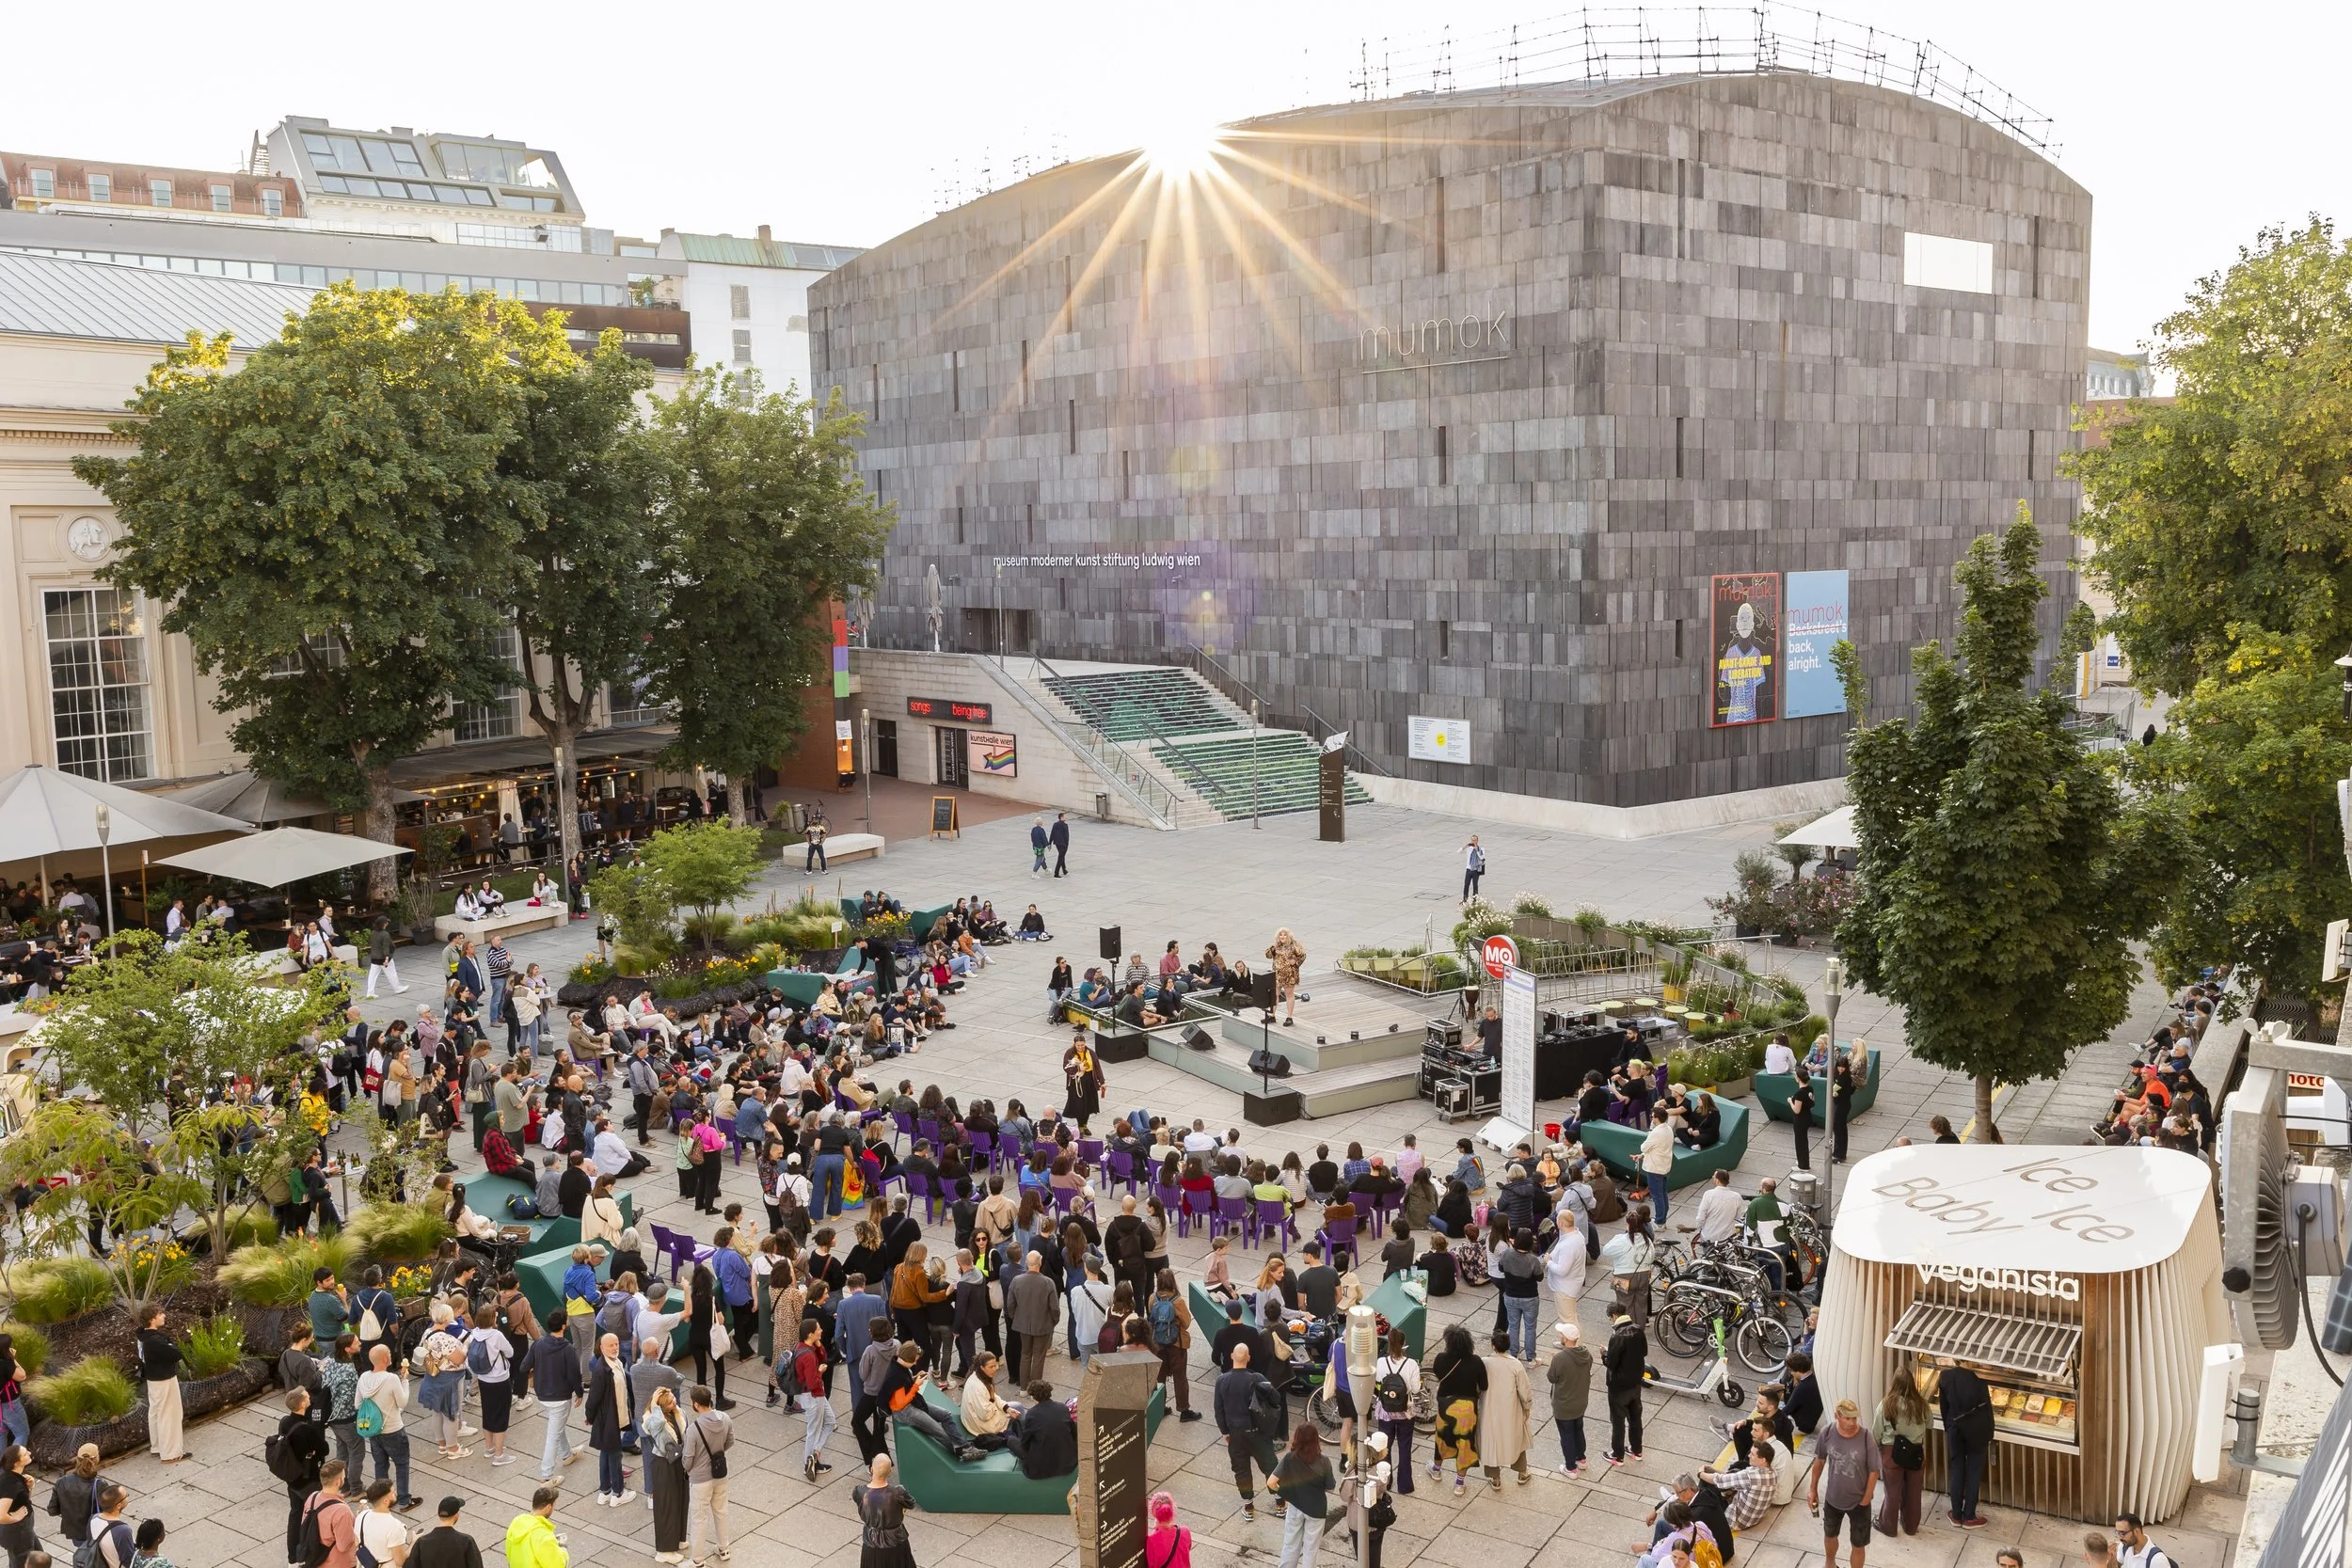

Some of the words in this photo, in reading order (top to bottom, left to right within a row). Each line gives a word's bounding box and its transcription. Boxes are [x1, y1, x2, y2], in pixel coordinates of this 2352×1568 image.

[1360, 300, 1508, 361] mumok
[993, 555, 1028, 566] museum
[1031, 553, 1073, 566] moderner
[1075, 553, 1101, 566] kunst
[1103, 552, 1139, 569] stiftung
[1142, 552, 1175, 569] ludwig
[1177, 552, 1200, 566] wien
[1719, 585, 1772, 602] mumok
[1788, 602, 1843, 625] mumok
[1788, 621, 1847, 637] Backstreet's
[1788, 639, 1815, 654] back,
[1760, 655, 1772, 665] AND
[1788, 656, 1821, 673] alright.
[910, 701, 931, 715] songs
[952, 703, 972, 720] being
[972, 705, 987, 719] free
[1486, 945, 1514, 966] MQ
[2002, 1157, 2099, 1194] Ice
[1871, 1176, 2025, 1235] Baby
[2031, 1204, 2135, 1243] Ice
[1914, 1259, 2080, 1302] veganista
